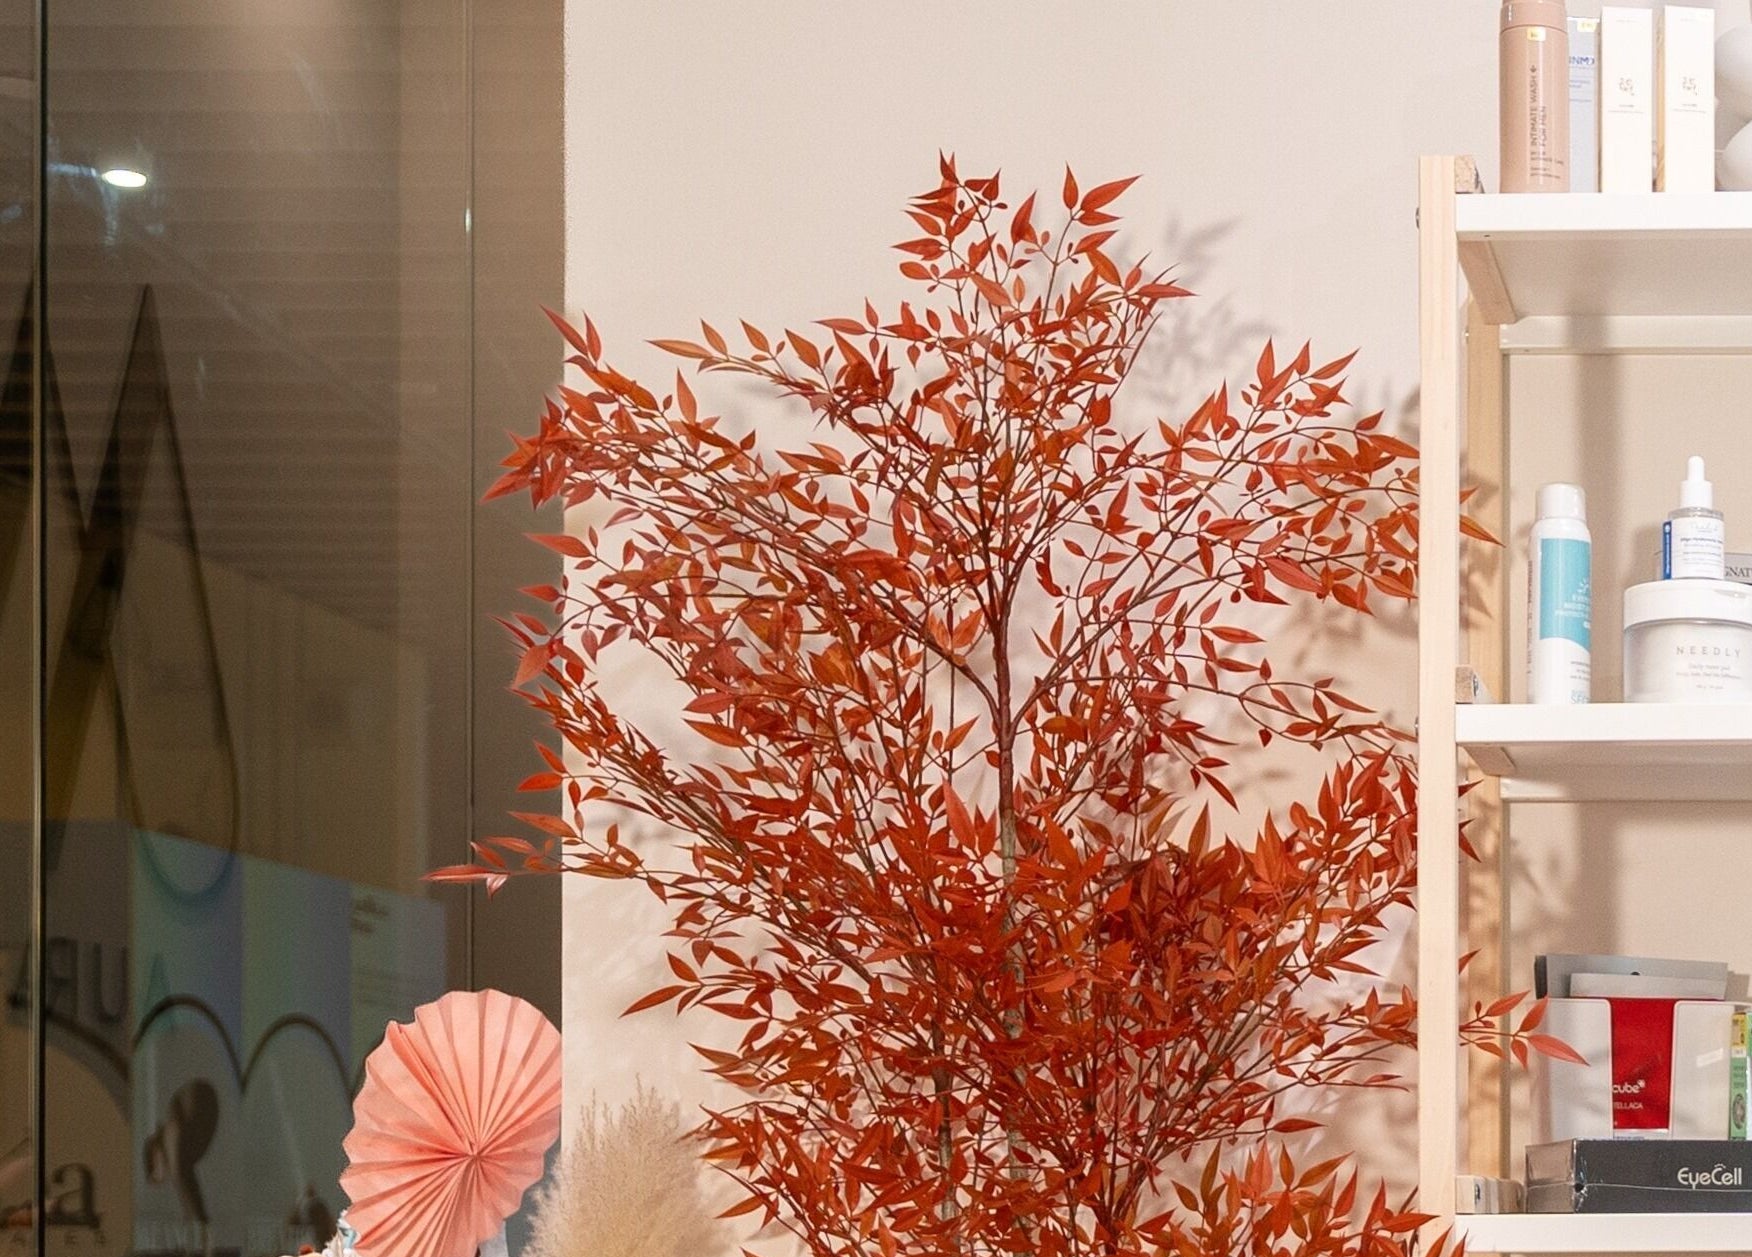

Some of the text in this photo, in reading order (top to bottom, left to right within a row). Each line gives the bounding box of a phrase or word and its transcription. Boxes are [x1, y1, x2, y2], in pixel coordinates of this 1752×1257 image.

[1676, 645, 1741, 658] NEEDLY
[1613, 1082, 1640, 1094] cube
[1677, 1165, 1742, 1190] EyeCell
